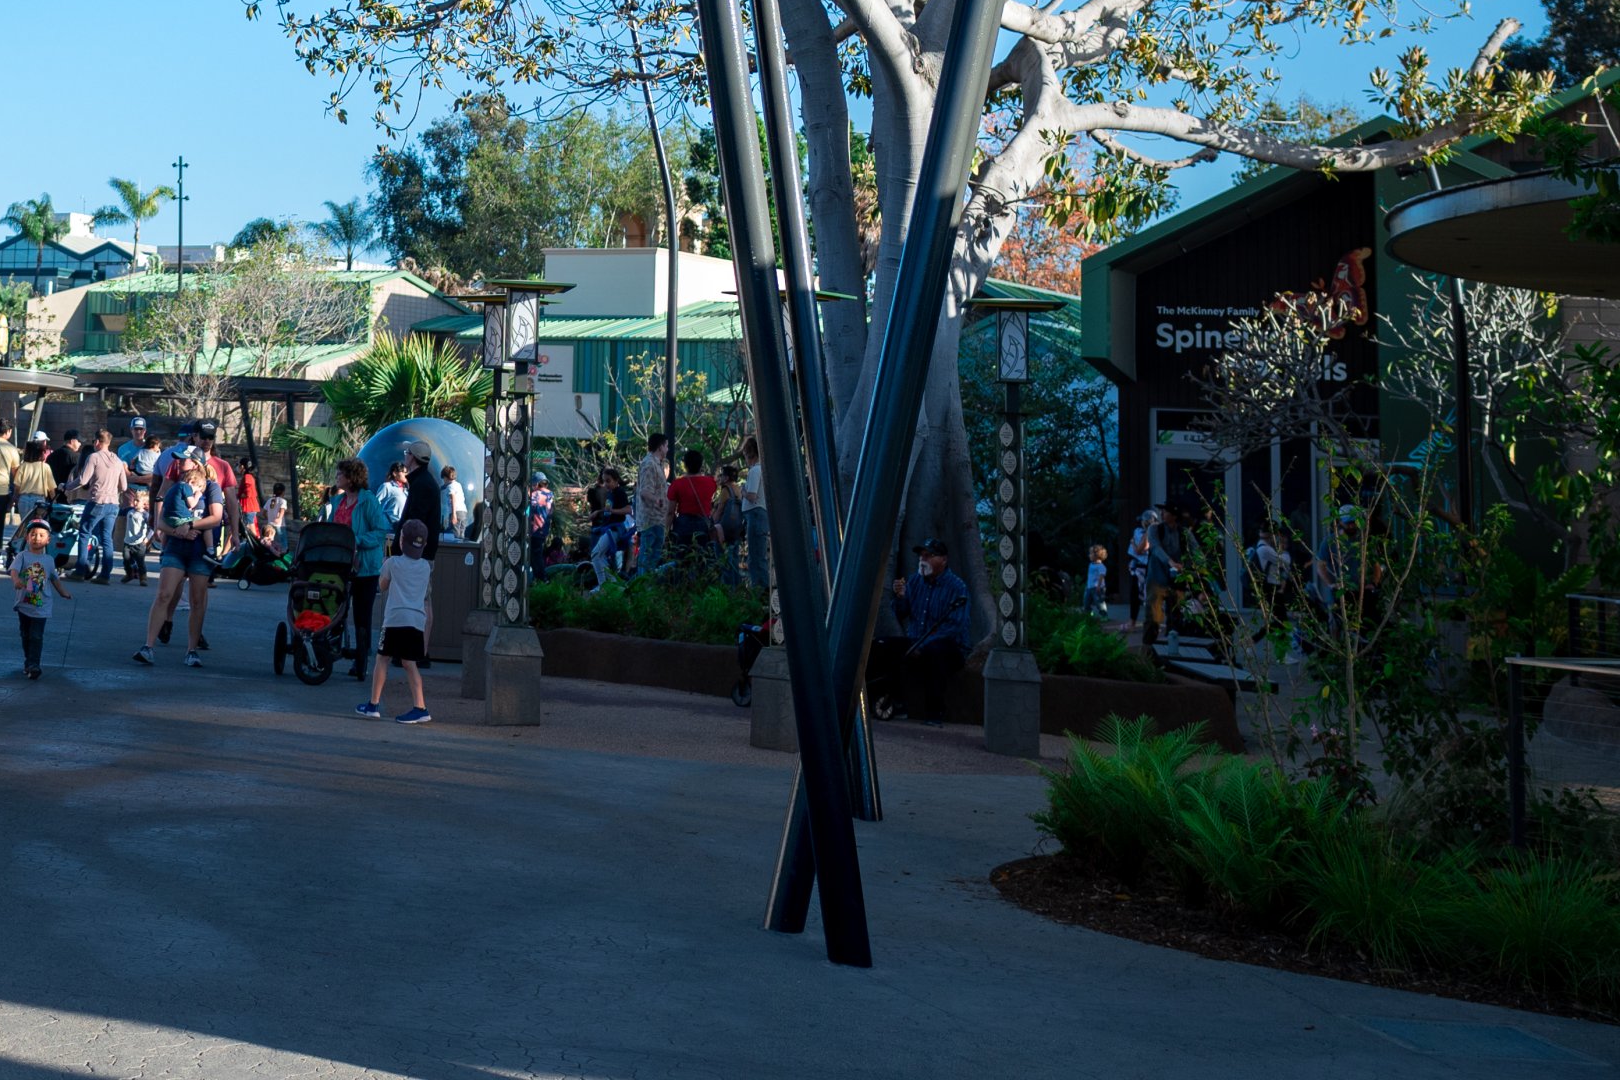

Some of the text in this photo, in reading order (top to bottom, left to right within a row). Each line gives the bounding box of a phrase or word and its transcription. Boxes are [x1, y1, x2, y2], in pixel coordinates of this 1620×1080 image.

[1156, 305, 1260, 317] The McKinney Family
[1156, 322, 1272, 353] Spine
